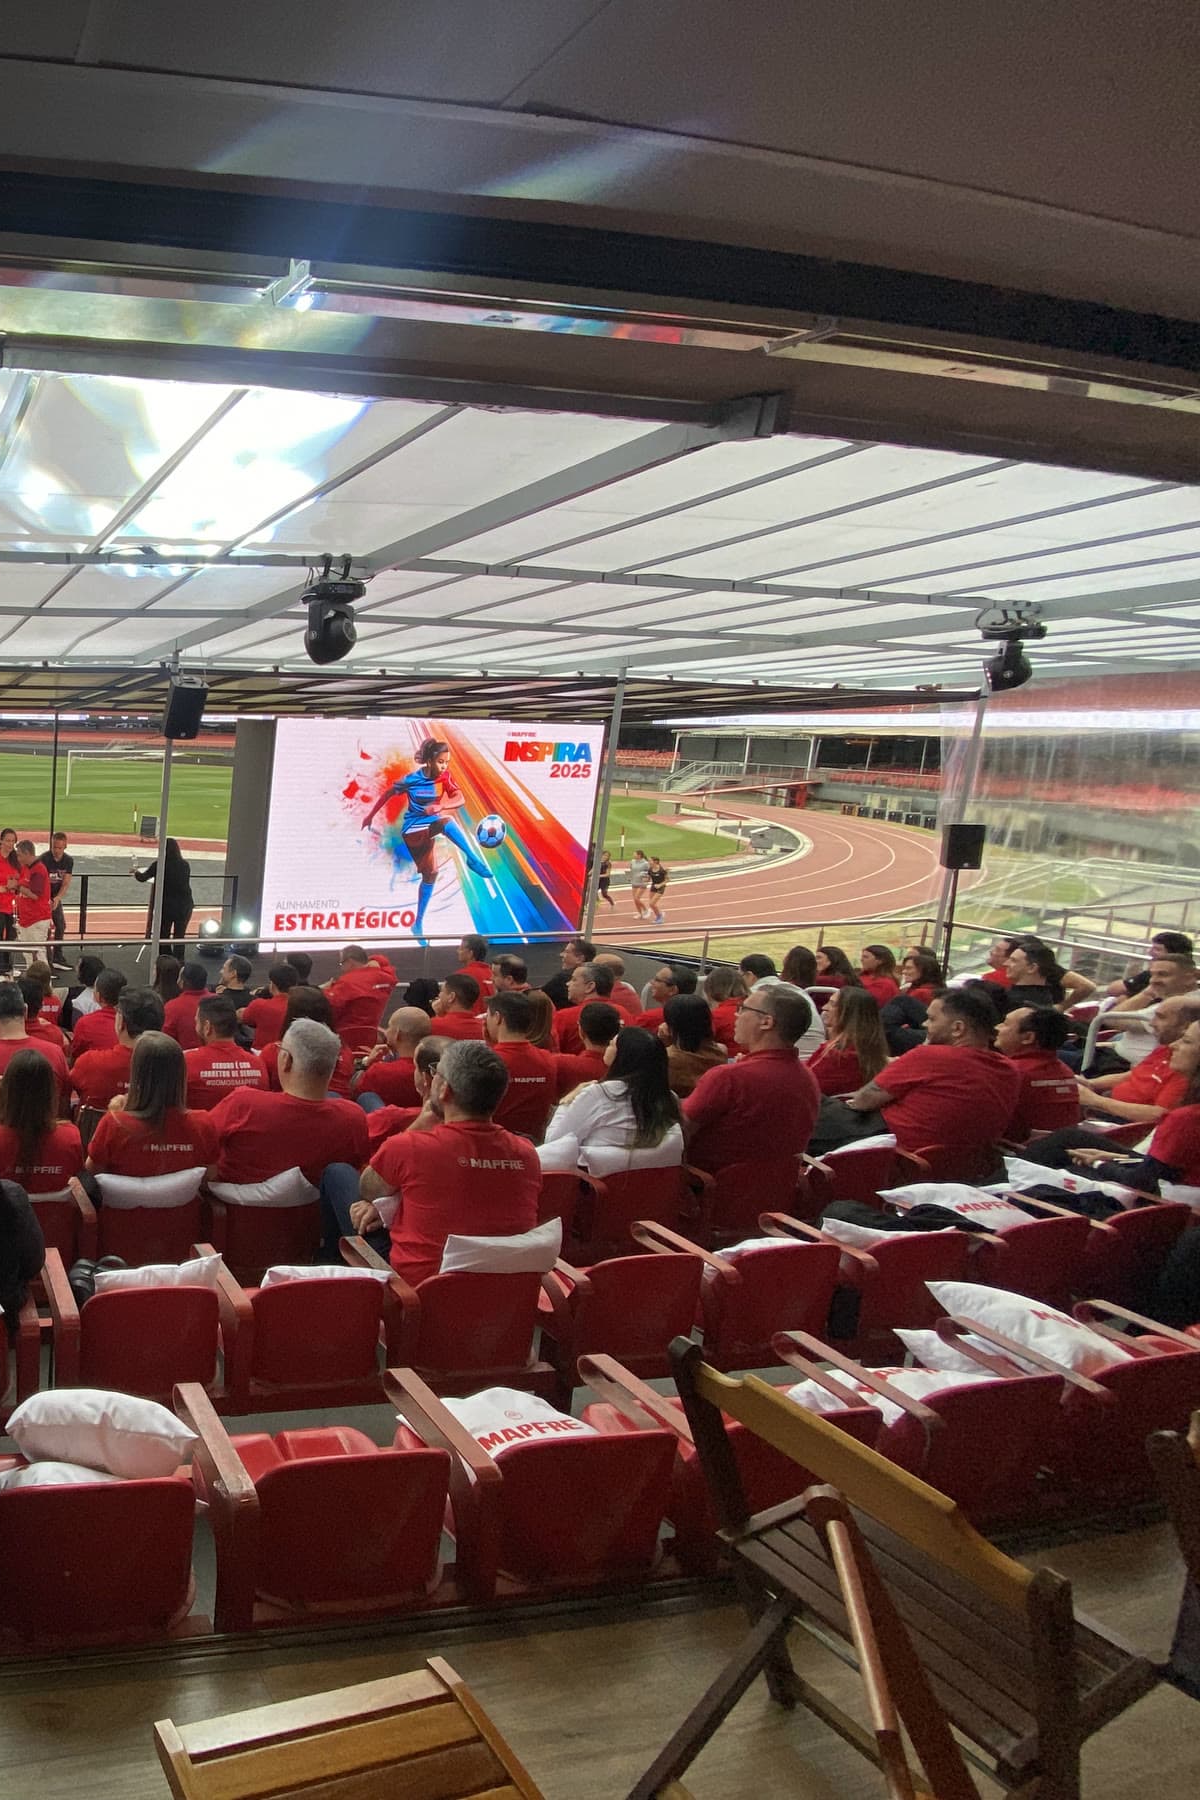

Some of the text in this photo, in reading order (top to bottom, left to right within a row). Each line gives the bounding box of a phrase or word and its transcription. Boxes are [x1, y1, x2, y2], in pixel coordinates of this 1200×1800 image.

[503, 741, 592, 762] INSPIRA
[549, 764, 591, 778] 2025
[275, 900, 340, 910] ALINHAMENTO
[273, 906, 416, 932] ESTRATÉGICO
[150, 1143, 194, 1152] MAPFRE
[15, 1165, 64, 1175] MPFRE
[469, 1158, 526, 1170] MAPFRE
[477, 1419, 583, 1451] MAPFRE
